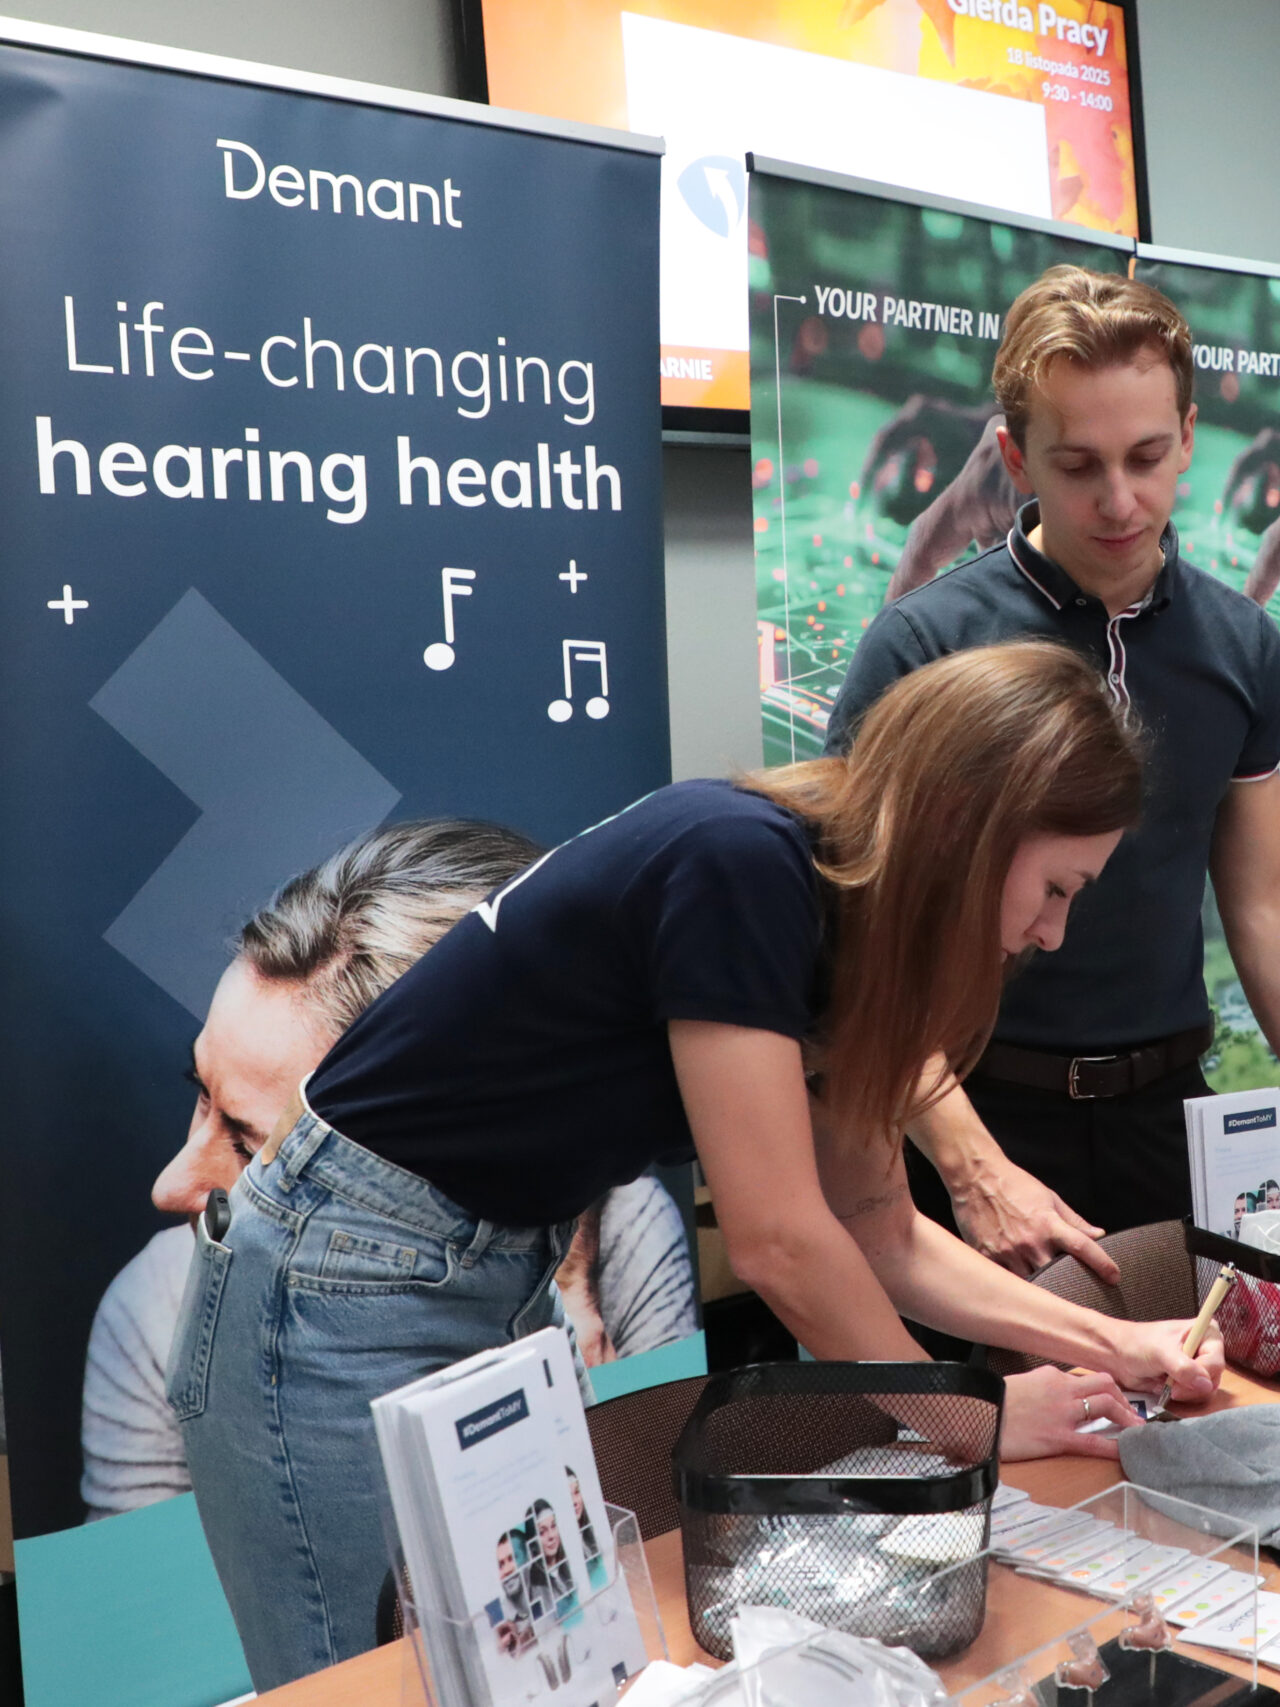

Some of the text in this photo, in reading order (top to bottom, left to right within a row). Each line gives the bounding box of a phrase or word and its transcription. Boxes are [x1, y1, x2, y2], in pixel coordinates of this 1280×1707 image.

[1038, 3, 1109, 57] Pracy
[1007, 47, 1112, 87] 18 listopada 2025
[1041, 81, 1071, 103] 9:30
[1079, 90, 1114, 112] 14:00
[215, 137, 463, 229] Demant
[814, 285, 1000, 340] YOUR PARTNER IN
[64, 295, 596, 426] Life-changing
[36, 416, 622, 525] hearing health
